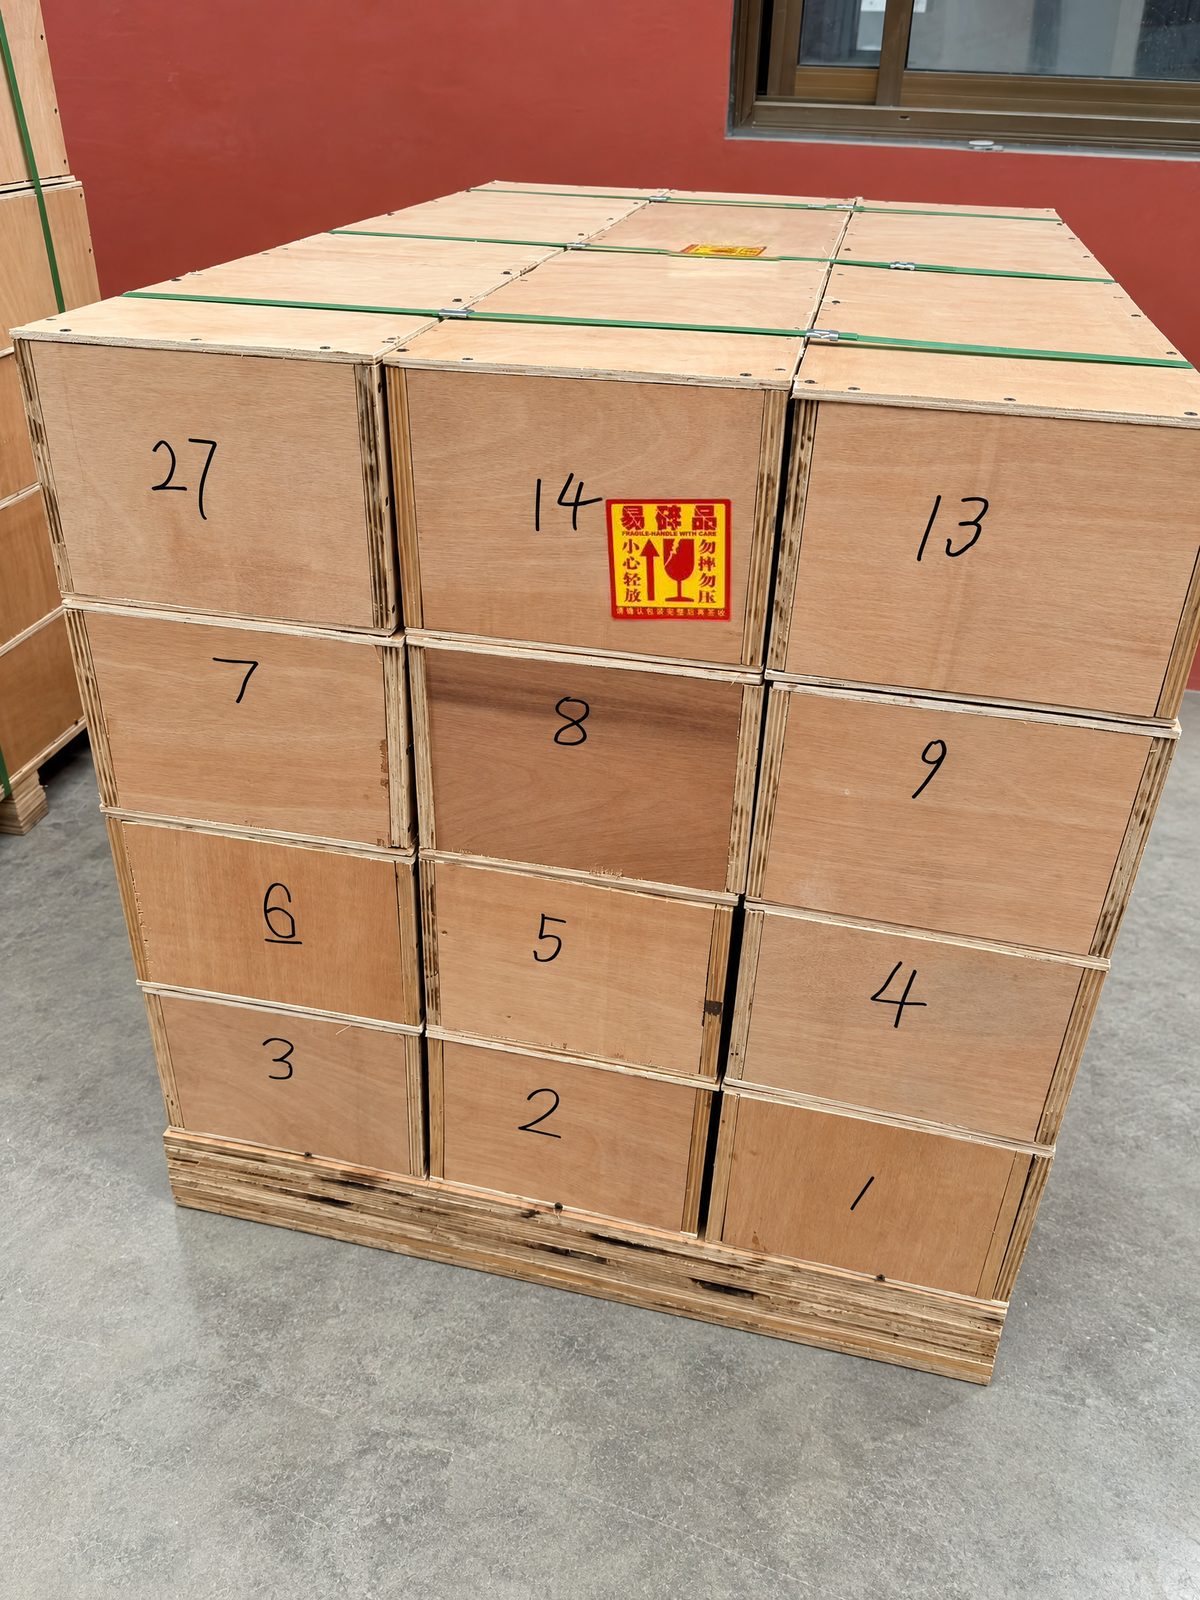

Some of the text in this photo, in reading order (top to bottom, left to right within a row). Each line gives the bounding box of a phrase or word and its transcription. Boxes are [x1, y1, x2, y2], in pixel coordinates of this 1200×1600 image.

[151, 438, 218, 521] 27
[535, 472, 603, 532] 14
[620, 505, 717, 531] 易碎品
[916, 494, 990, 562] 13
[622, 538, 642, 603] 小心轻放
[698, 539, 716, 604] 勿摔勿压
[212, 657, 259, 704] 7
[553, 697, 590, 746] 8
[911, 739, 948, 800] 9
[263, 882, 303, 945] 6
[532, 913, 567, 963] 5
[870, 960, 928, 1029] 4
[262, 1037, 295, 1081] 3
[517, 1088, 562, 1139] 2
[849, 1175, 875, 1211] 1
